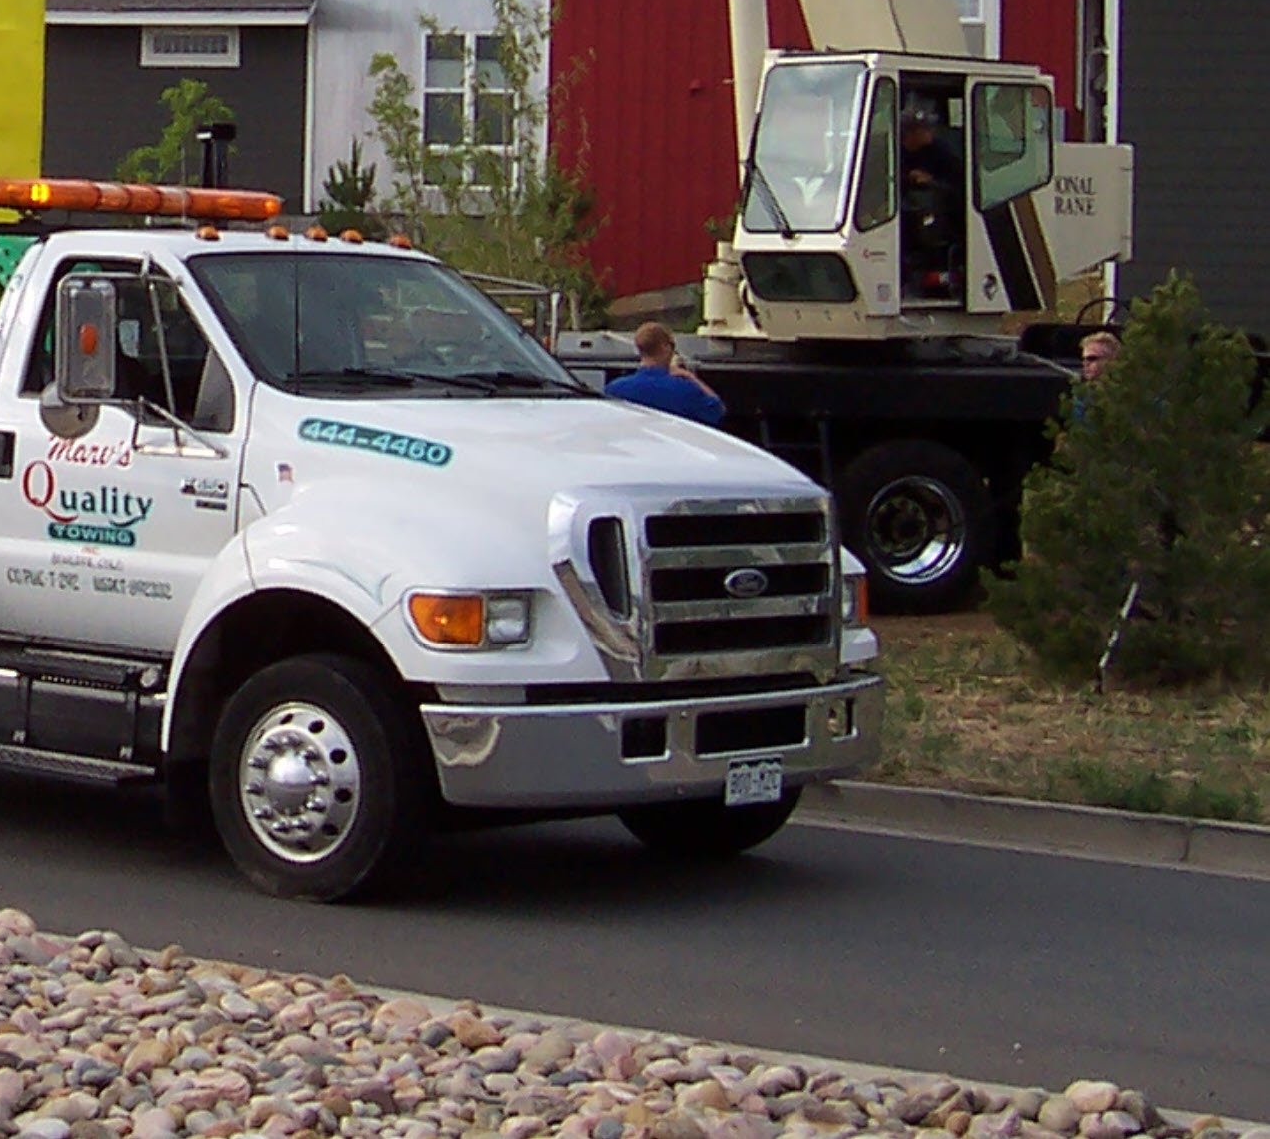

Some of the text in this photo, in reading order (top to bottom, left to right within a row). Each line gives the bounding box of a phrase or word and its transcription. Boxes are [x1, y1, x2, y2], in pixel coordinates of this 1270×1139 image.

[1054, 196, 1097, 216] RANE
[302, 419, 449, 464] 444-4460
[22, 459, 154, 528] Quality
[52, 523, 132, 545] TOWING
